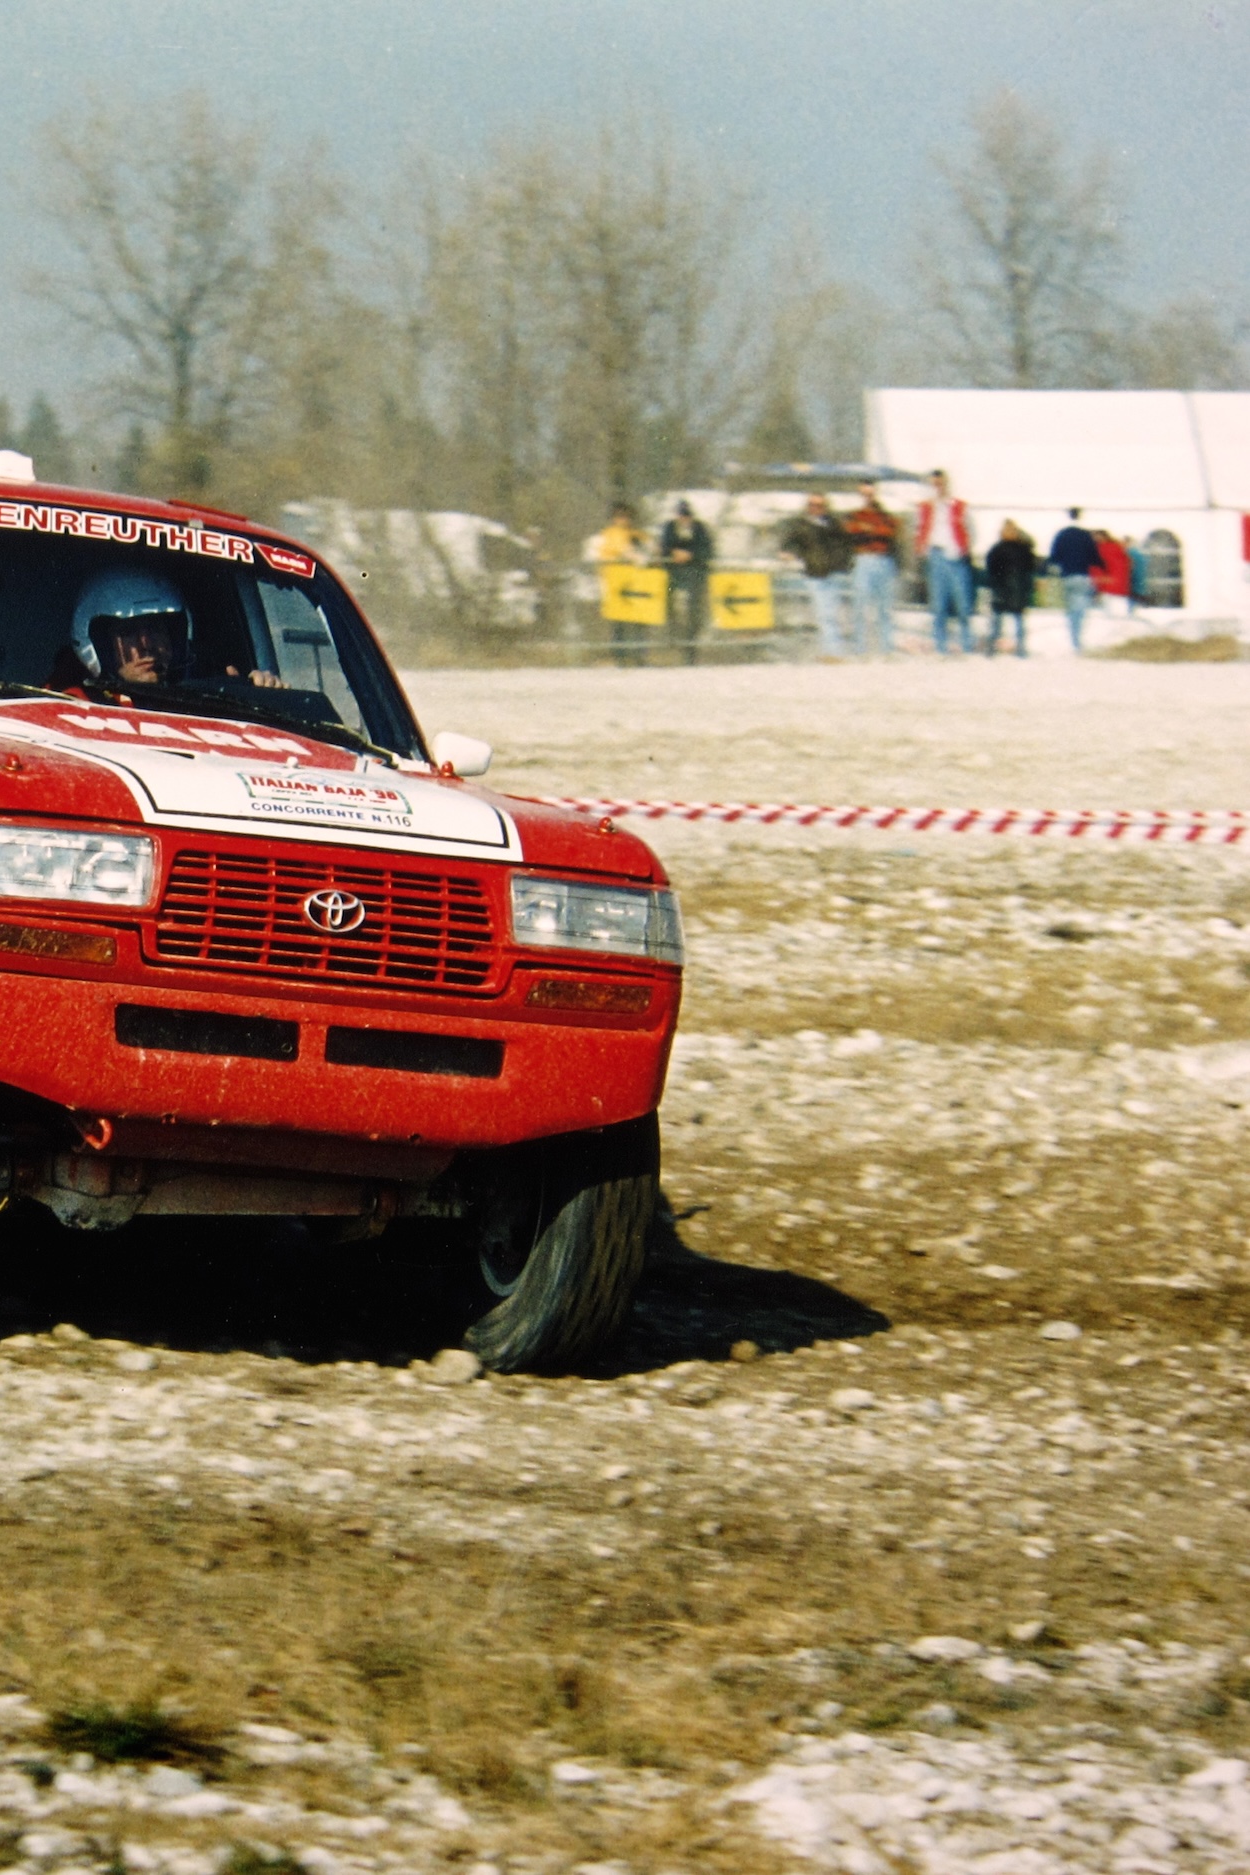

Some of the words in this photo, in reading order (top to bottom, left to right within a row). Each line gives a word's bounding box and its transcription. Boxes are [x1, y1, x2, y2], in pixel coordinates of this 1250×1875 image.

[57, 713, 312, 756] WARN
[250, 775, 318, 792] ITALIAN
[324, 785, 366, 798] BAJA
[251, 802, 365, 821] CONCORRENTE
